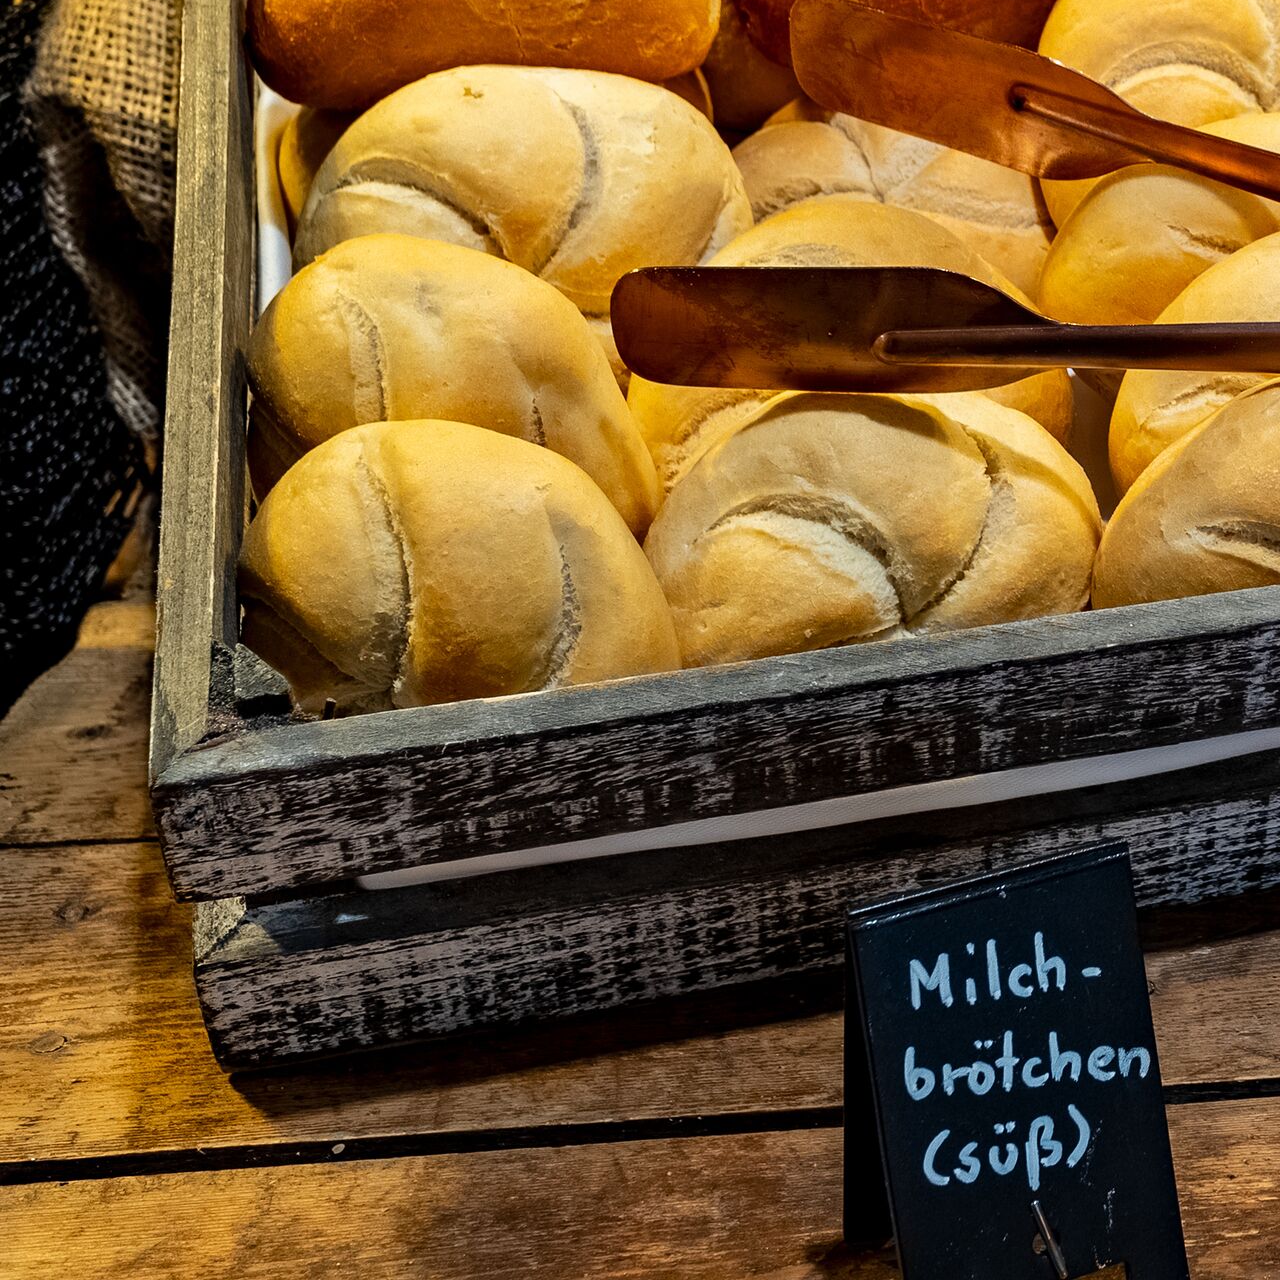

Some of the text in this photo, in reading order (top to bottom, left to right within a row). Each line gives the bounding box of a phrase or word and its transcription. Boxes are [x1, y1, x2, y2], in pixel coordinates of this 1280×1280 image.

[908, 930, 1103, 1011] Milch-
[904, 1030, 1151, 1101] brötchen
[922, 1103, 1091, 1192] (süß)
